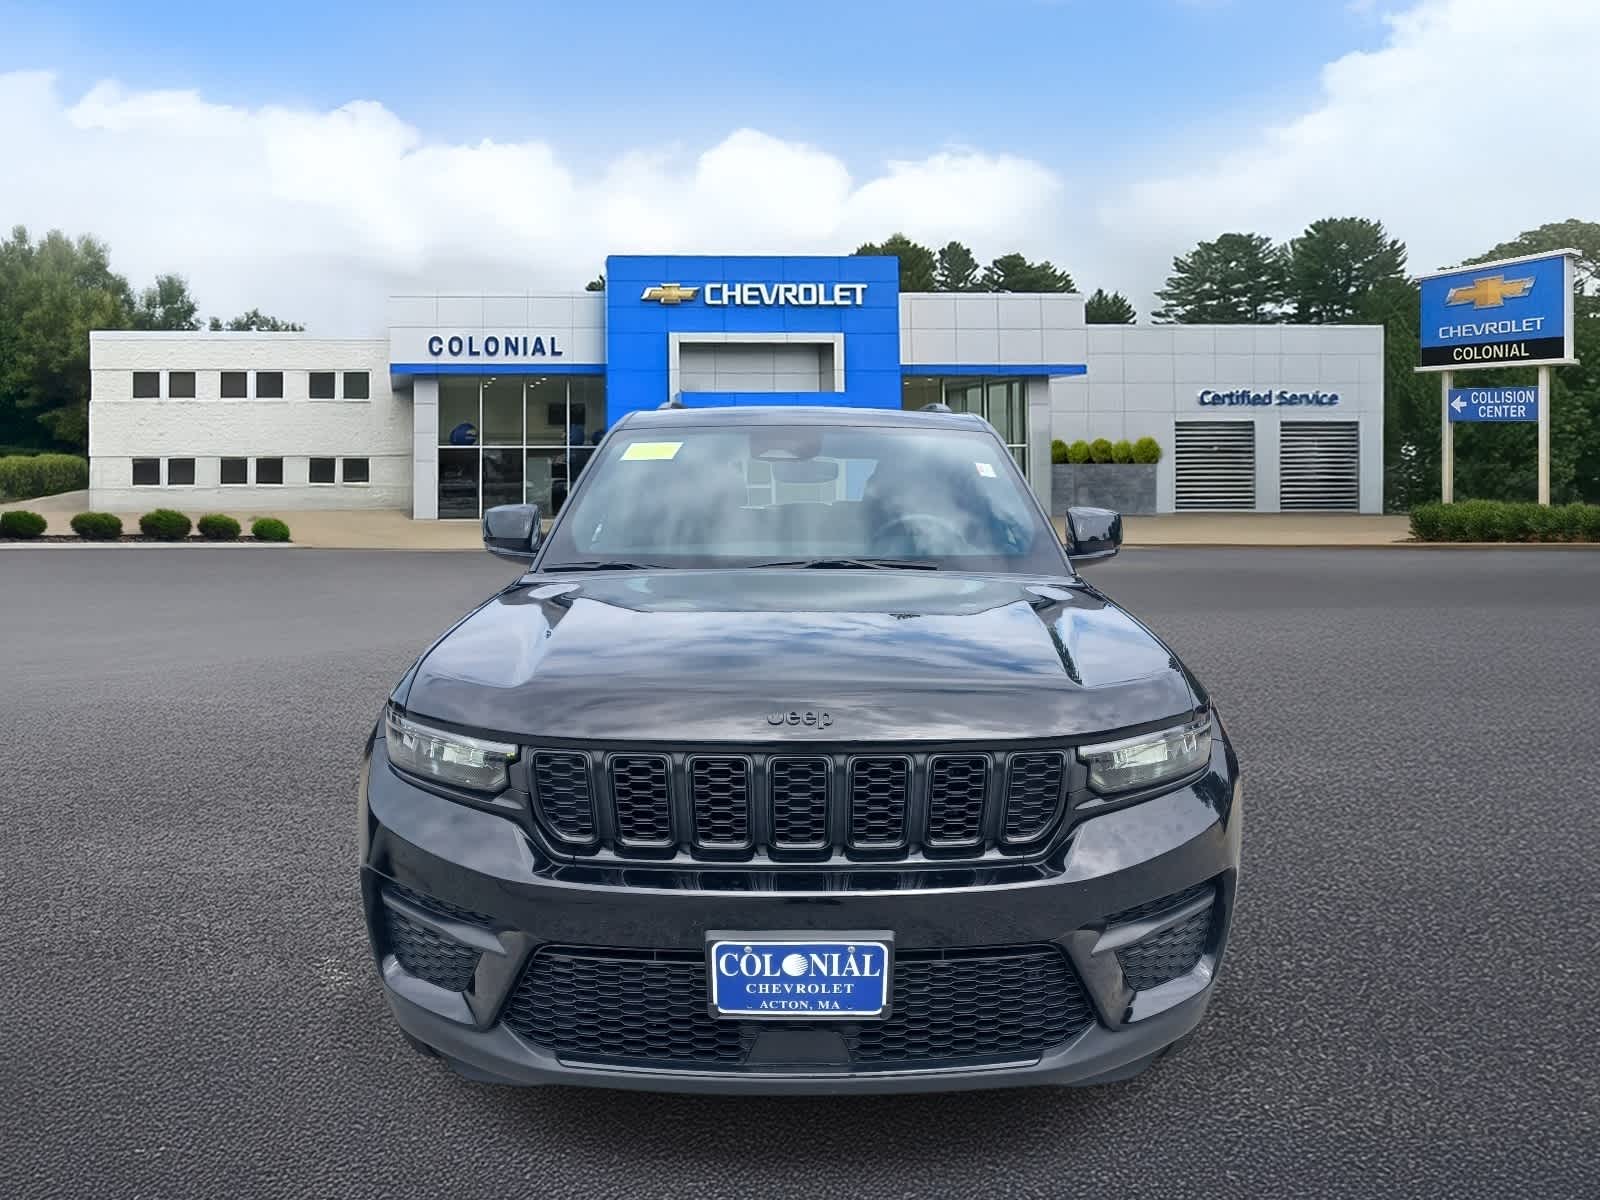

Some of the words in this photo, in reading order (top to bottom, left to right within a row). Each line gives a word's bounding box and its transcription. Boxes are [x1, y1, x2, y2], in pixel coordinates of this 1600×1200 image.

[704, 283, 868, 305] CHEVROLET
[1438, 317, 1545, 339] CHEVROLET
[427, 335, 563, 357] COLONIAL
[1452, 343, 1530, 361] COLONIAL
[1199, 389, 1273, 406] Certified
[1275, 390, 1339, 406] Service
[1471, 390, 1535, 404] COLLISION
[1478, 405, 1526, 418] CENTER
[767, 711, 834, 730] Jeep
[719, 952, 881, 977] COLONIAL
[745, 983, 855, 994] CHEVROLET
[759, 1000, 813, 1011] ACTON,
[818, 1000, 841, 1010] MA
